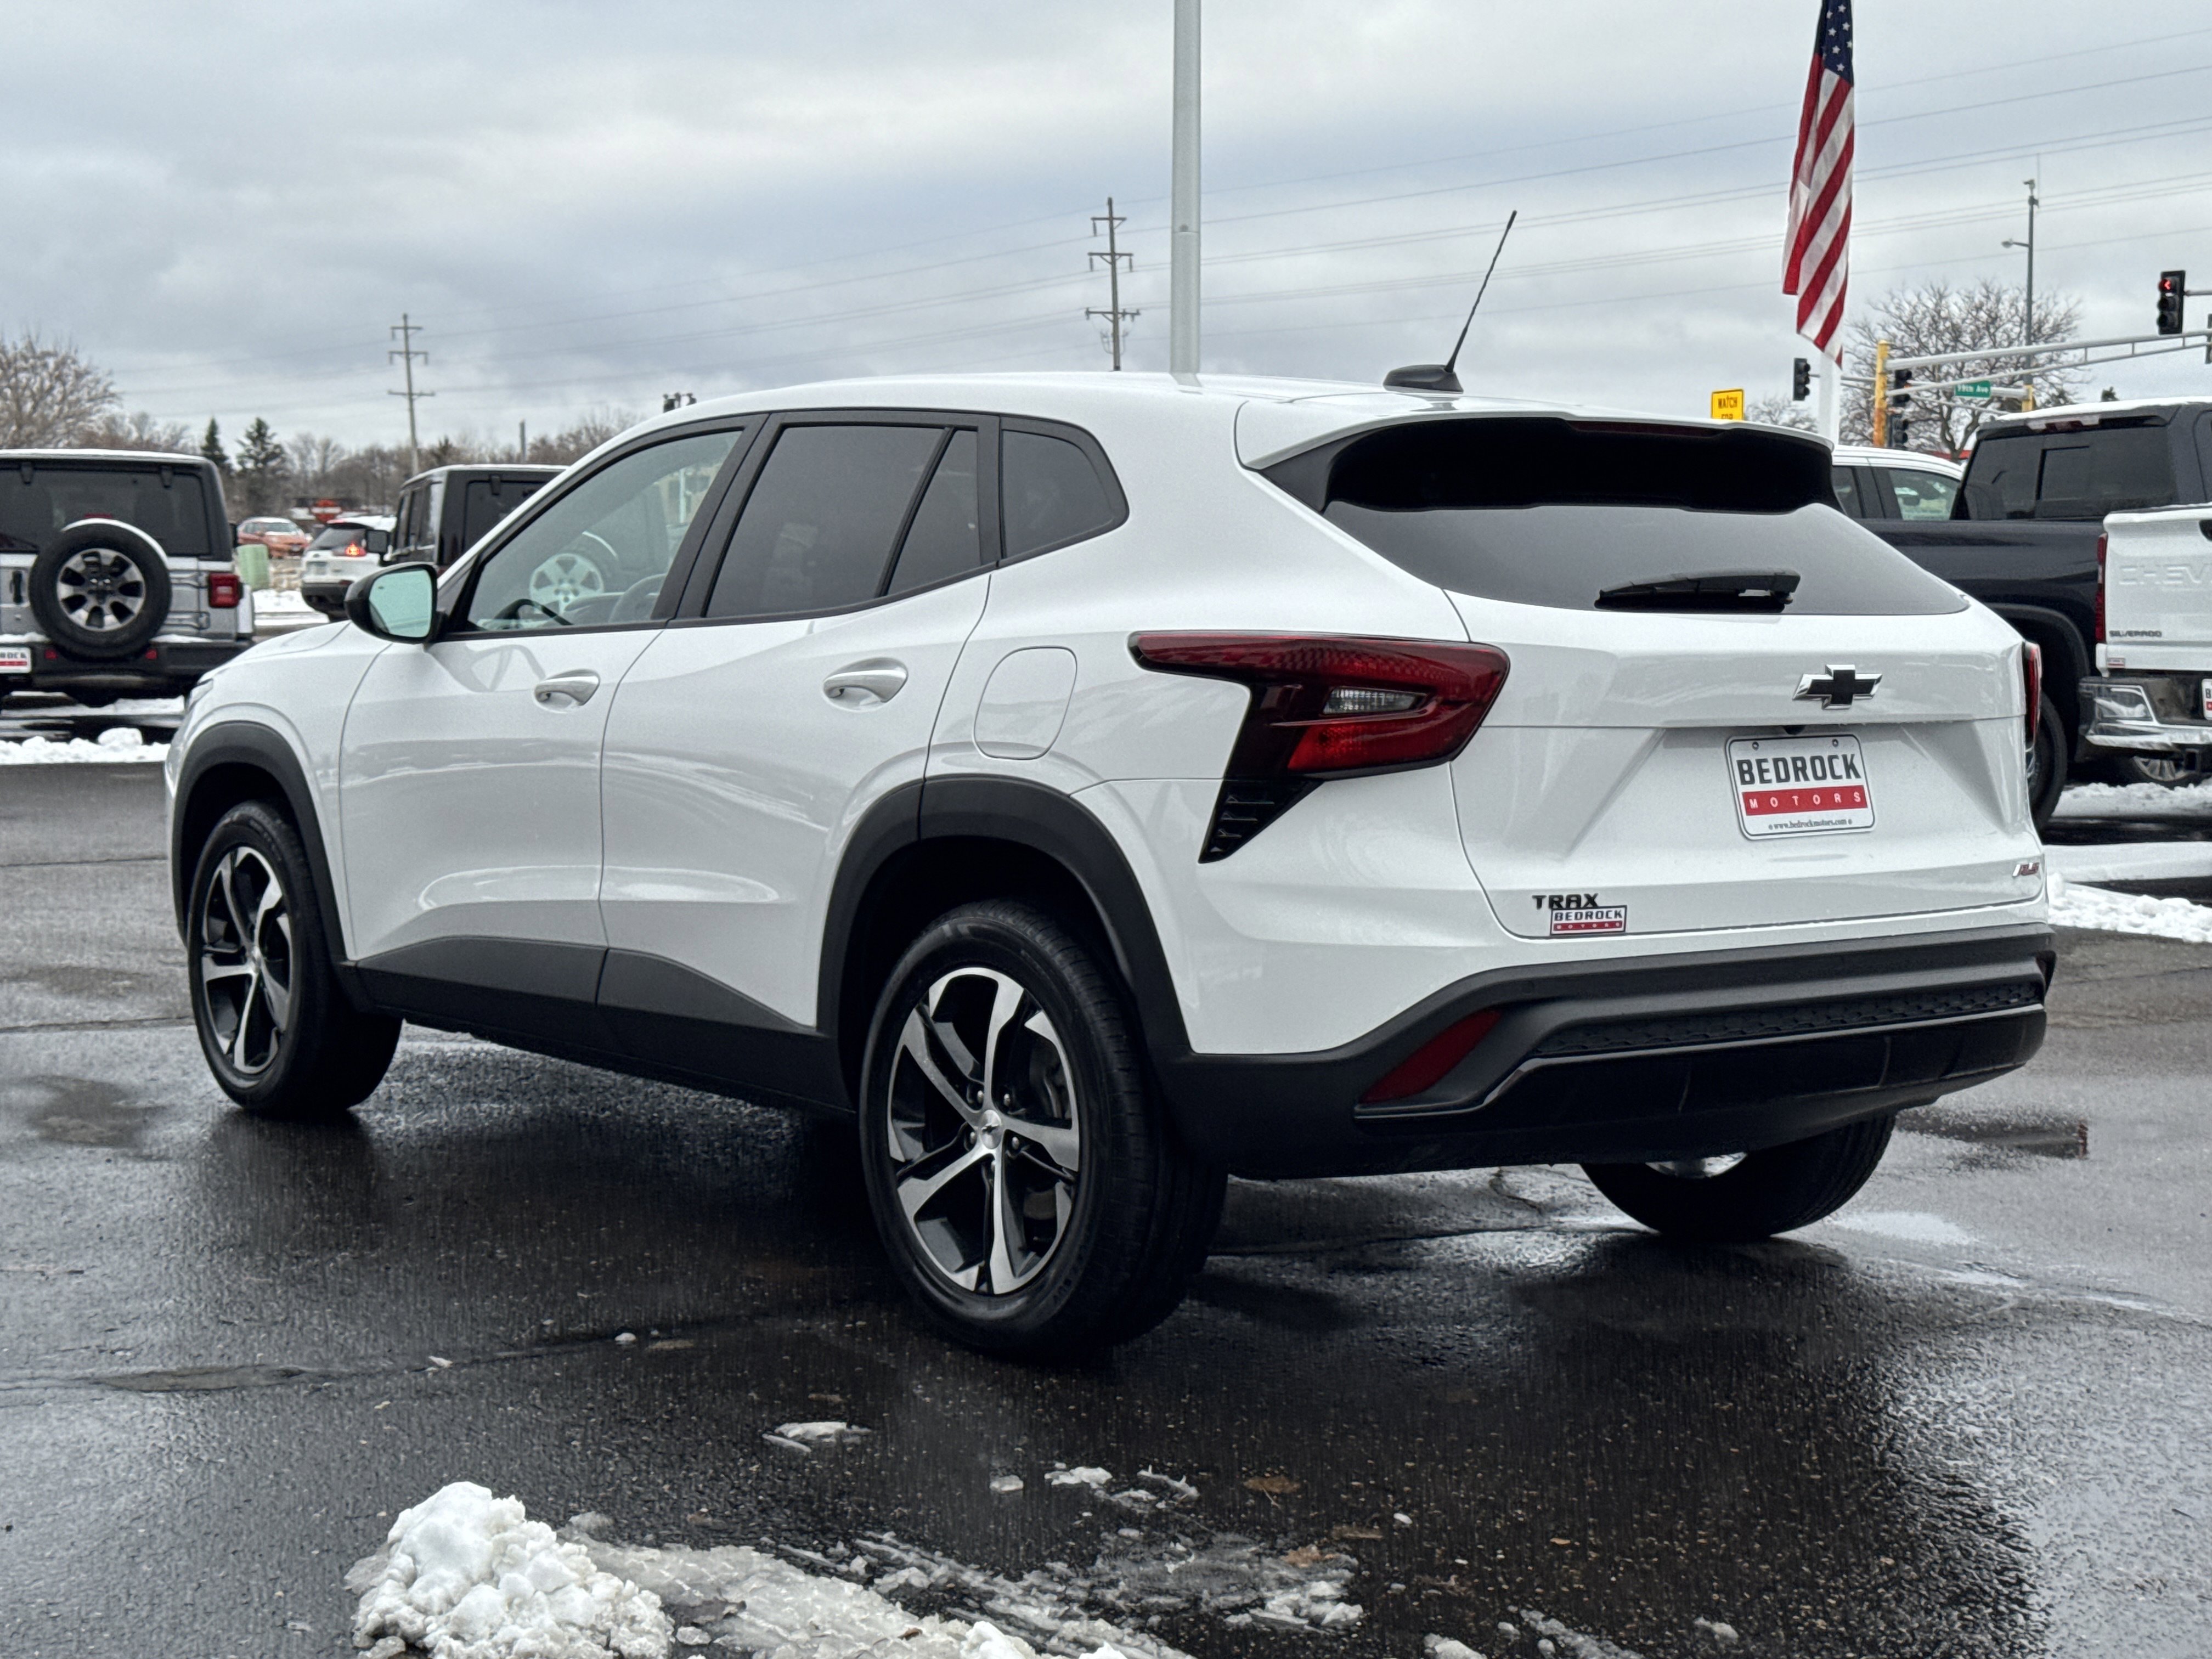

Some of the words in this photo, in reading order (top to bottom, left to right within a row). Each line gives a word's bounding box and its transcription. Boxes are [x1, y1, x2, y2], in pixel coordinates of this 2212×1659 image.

[1736, 753, 1861, 785] BEDROCK
[1749, 792, 1861, 809] MOTORS
[1532, 893, 1598, 910] TRAX
[1554, 910, 1622, 921] BEDROCK
